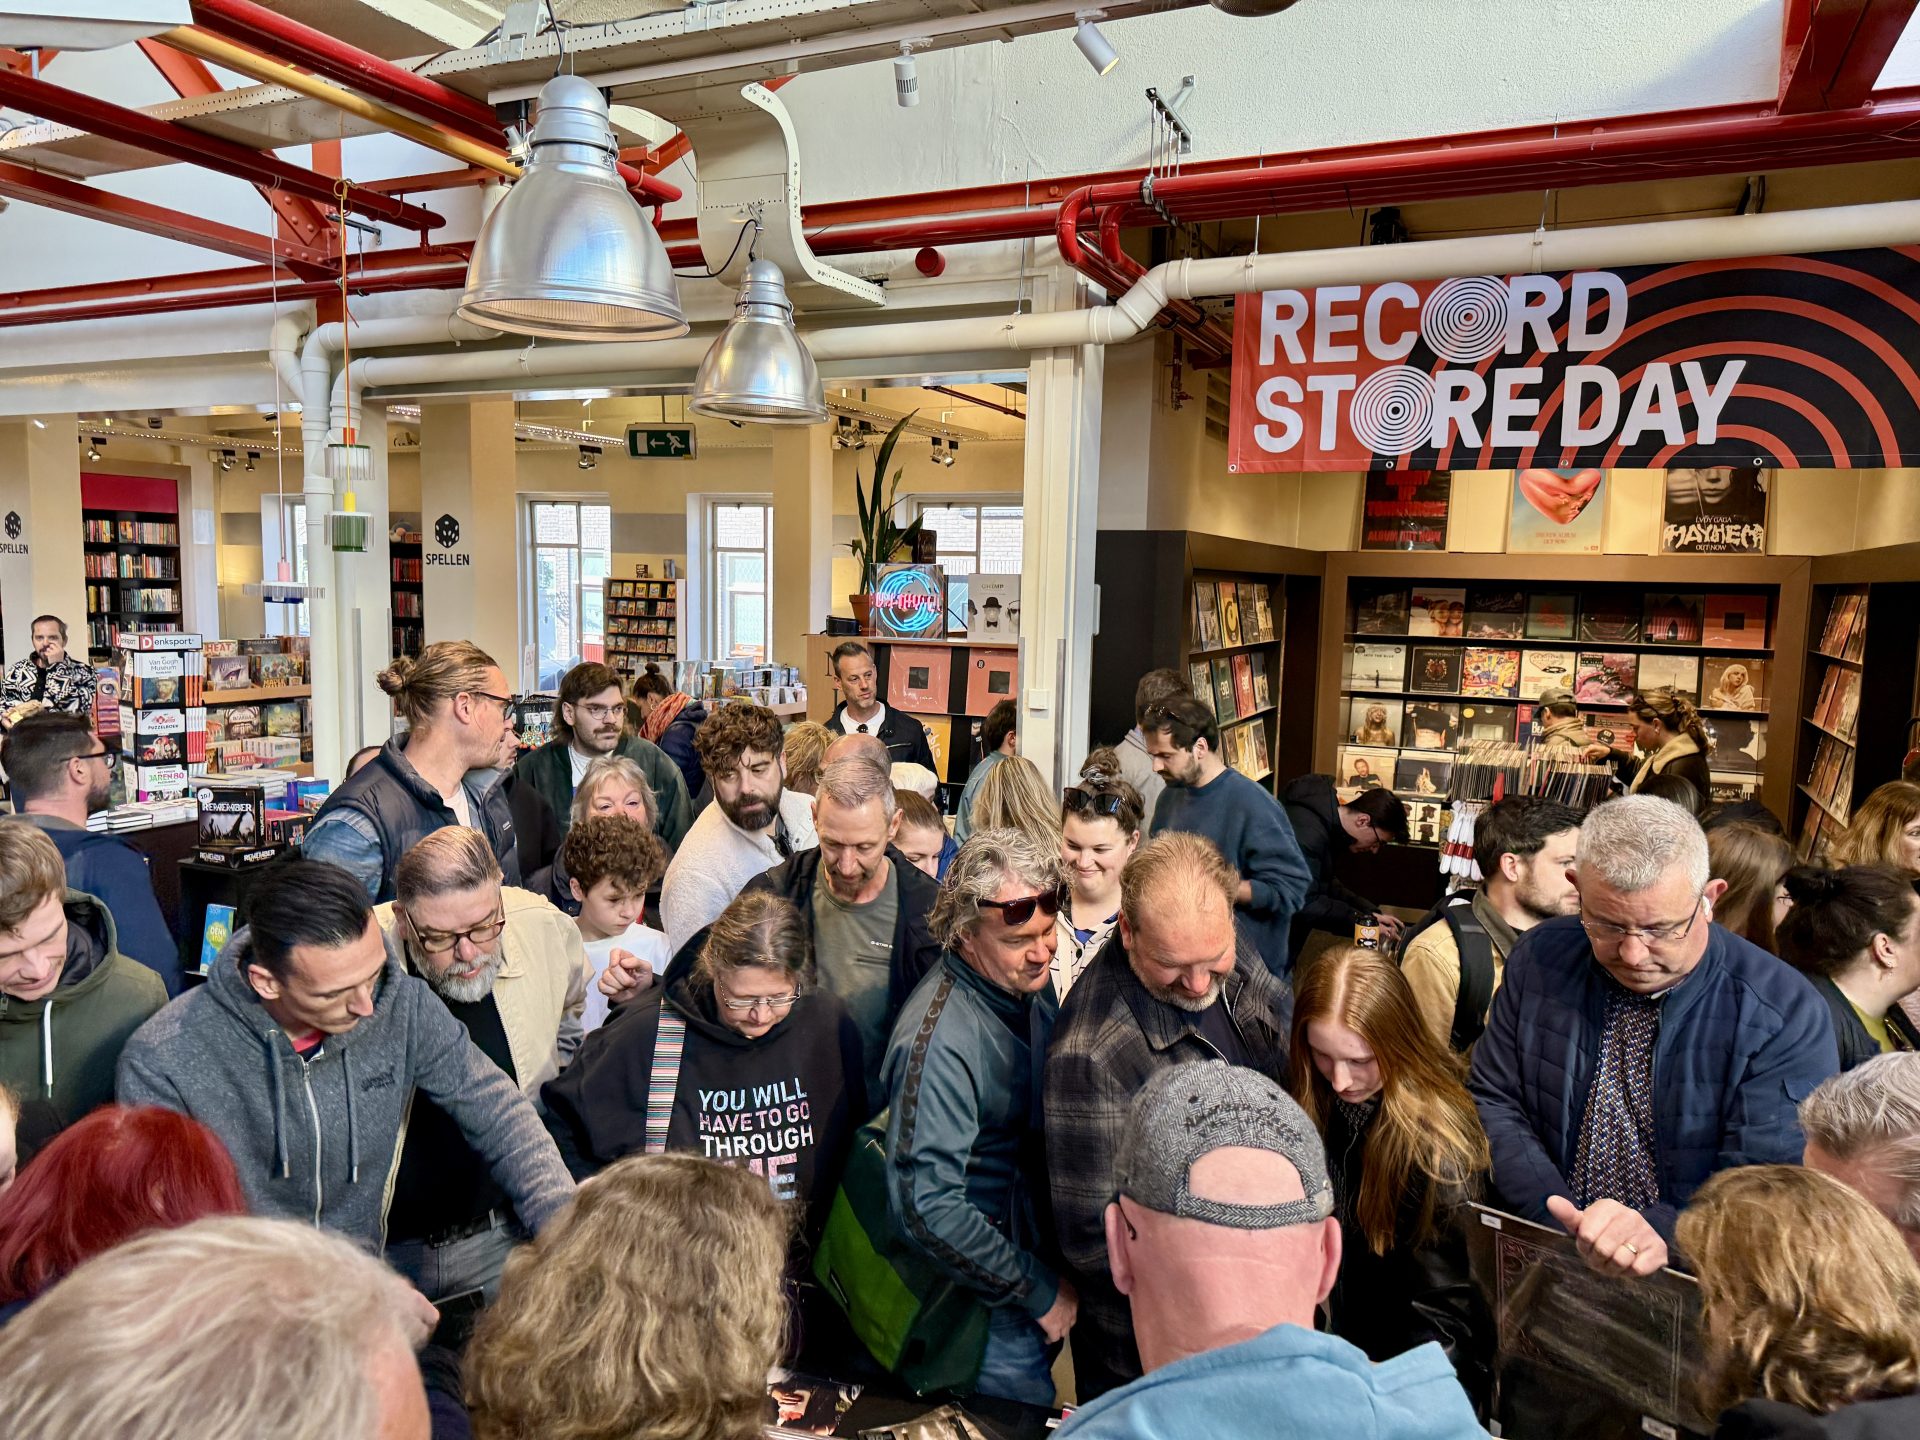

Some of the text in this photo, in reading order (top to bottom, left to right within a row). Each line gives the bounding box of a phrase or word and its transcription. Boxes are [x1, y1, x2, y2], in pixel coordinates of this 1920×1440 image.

[1259, 272, 1629, 366] RECORD
[1253, 360, 1747, 456] STORE DAY
[1400, 530, 1417, 542] OUT
[1420, 530, 1441, 542] NOW
[1663, 523, 1764, 550] MAYHEM
[425, 553, 470, 566] SPELLEN
[142, 636, 192, 649] Denksport
[206, 643, 232, 653] HEAT
[161, 659, 178, 668] Gogh
[226, 755, 255, 766] INGSPAN
[149, 773, 173, 782] JAREN
[202, 803, 252, 812] REMEMBER
[199, 851, 225, 861] REMEMBER
[243, 849, 276, 861] REMEMBER
[698, 1077, 807, 1112] YOU WILL
[699, 1101, 810, 1134] HAVE TO GO
[699, 1124, 814, 1158] THROUGH
